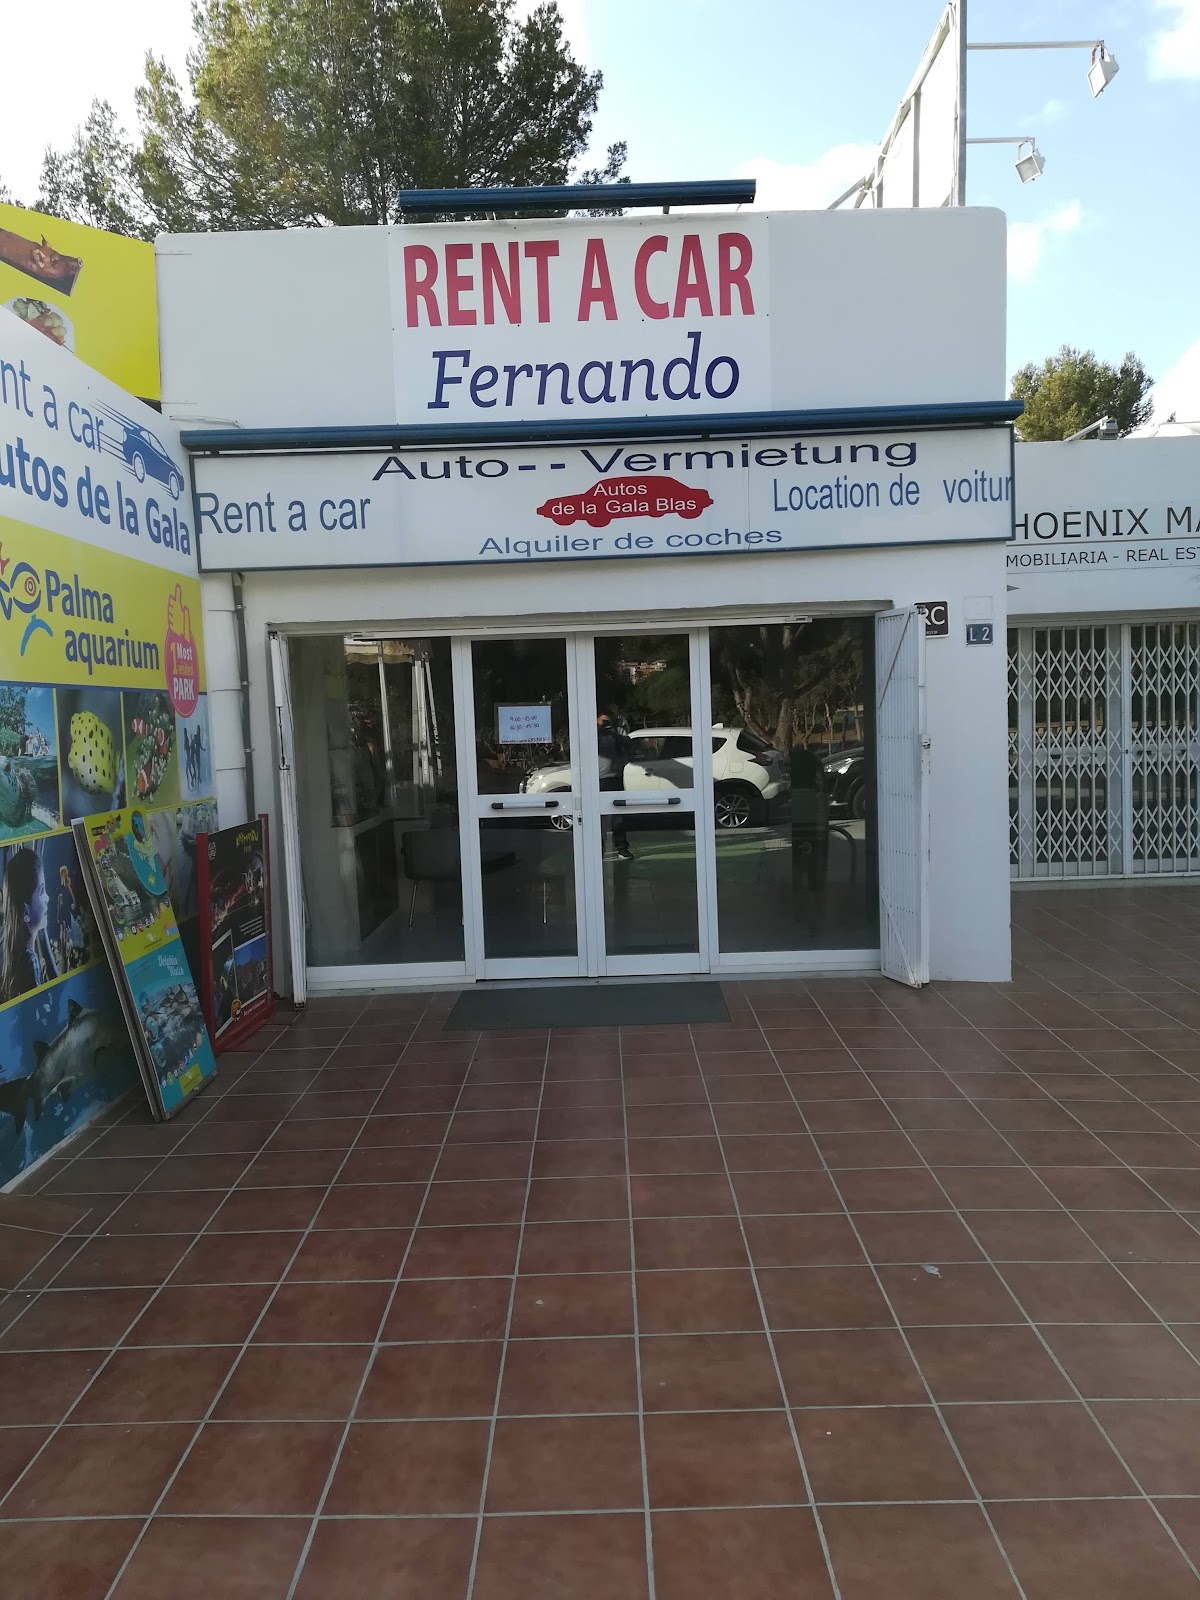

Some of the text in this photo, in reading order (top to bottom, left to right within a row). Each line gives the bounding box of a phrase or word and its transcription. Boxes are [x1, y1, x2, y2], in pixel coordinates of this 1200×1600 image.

[403, 232, 755, 327] RENT A CAR
[427, 331, 740, 409] Fernando
[43, 384, 59, 431] a
[68, 401, 104, 454] car
[581, 442, 917, 473] Vermietung
[593, 482, 648, 497] Autos
[773, 475, 880, 512] Location
[888, 473, 920, 506] de
[76, 466, 111, 525] de
[116, 481, 139, 536] la
[145, 497, 191, 556] Gala
[196, 492, 371, 534] Rent a car
[551, 497, 697, 516] de la Gala Blas
[1167, 506, 1200, 534] M
[479, 527, 783, 557] Alquiler de coches
[1126, 548, 1169, 562] REAL
[1175, 546, 1200, 560] ES
[44, 569, 114, 624] Palma
[982, 626, 990, 640] 2
[65, 628, 160, 676] aquarium
[176, 642, 193, 661] Most
[173, 677, 195, 700] PARK
